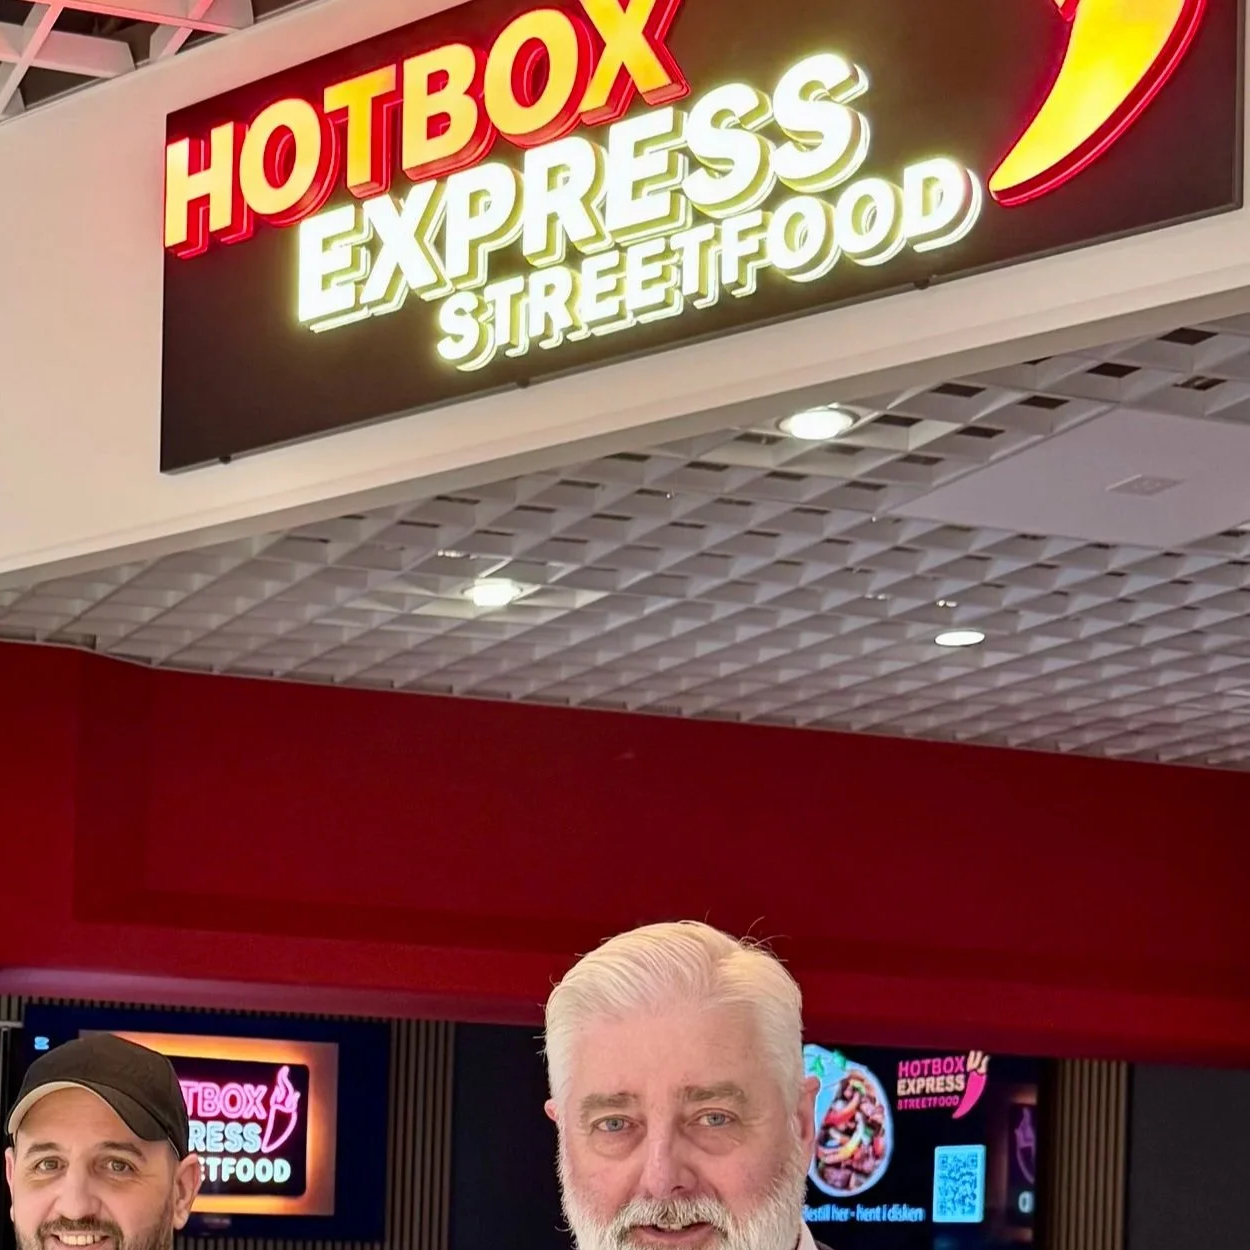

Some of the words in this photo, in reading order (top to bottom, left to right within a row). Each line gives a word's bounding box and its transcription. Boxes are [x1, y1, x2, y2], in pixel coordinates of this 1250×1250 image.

[164, 0, 691, 259] HOTBOX
[297, 52, 870, 333] EXPRESS
[435, 157, 981, 370] STREETFOOD
[897, 1074, 965, 1096] EXPRESS
[898, 1056, 965, 1078] HOTBOX
[179, 1080, 268, 1120] TBOX
[897, 1095, 959, 1110] STREETFOOD
[189, 1120, 262, 1153] RESS
